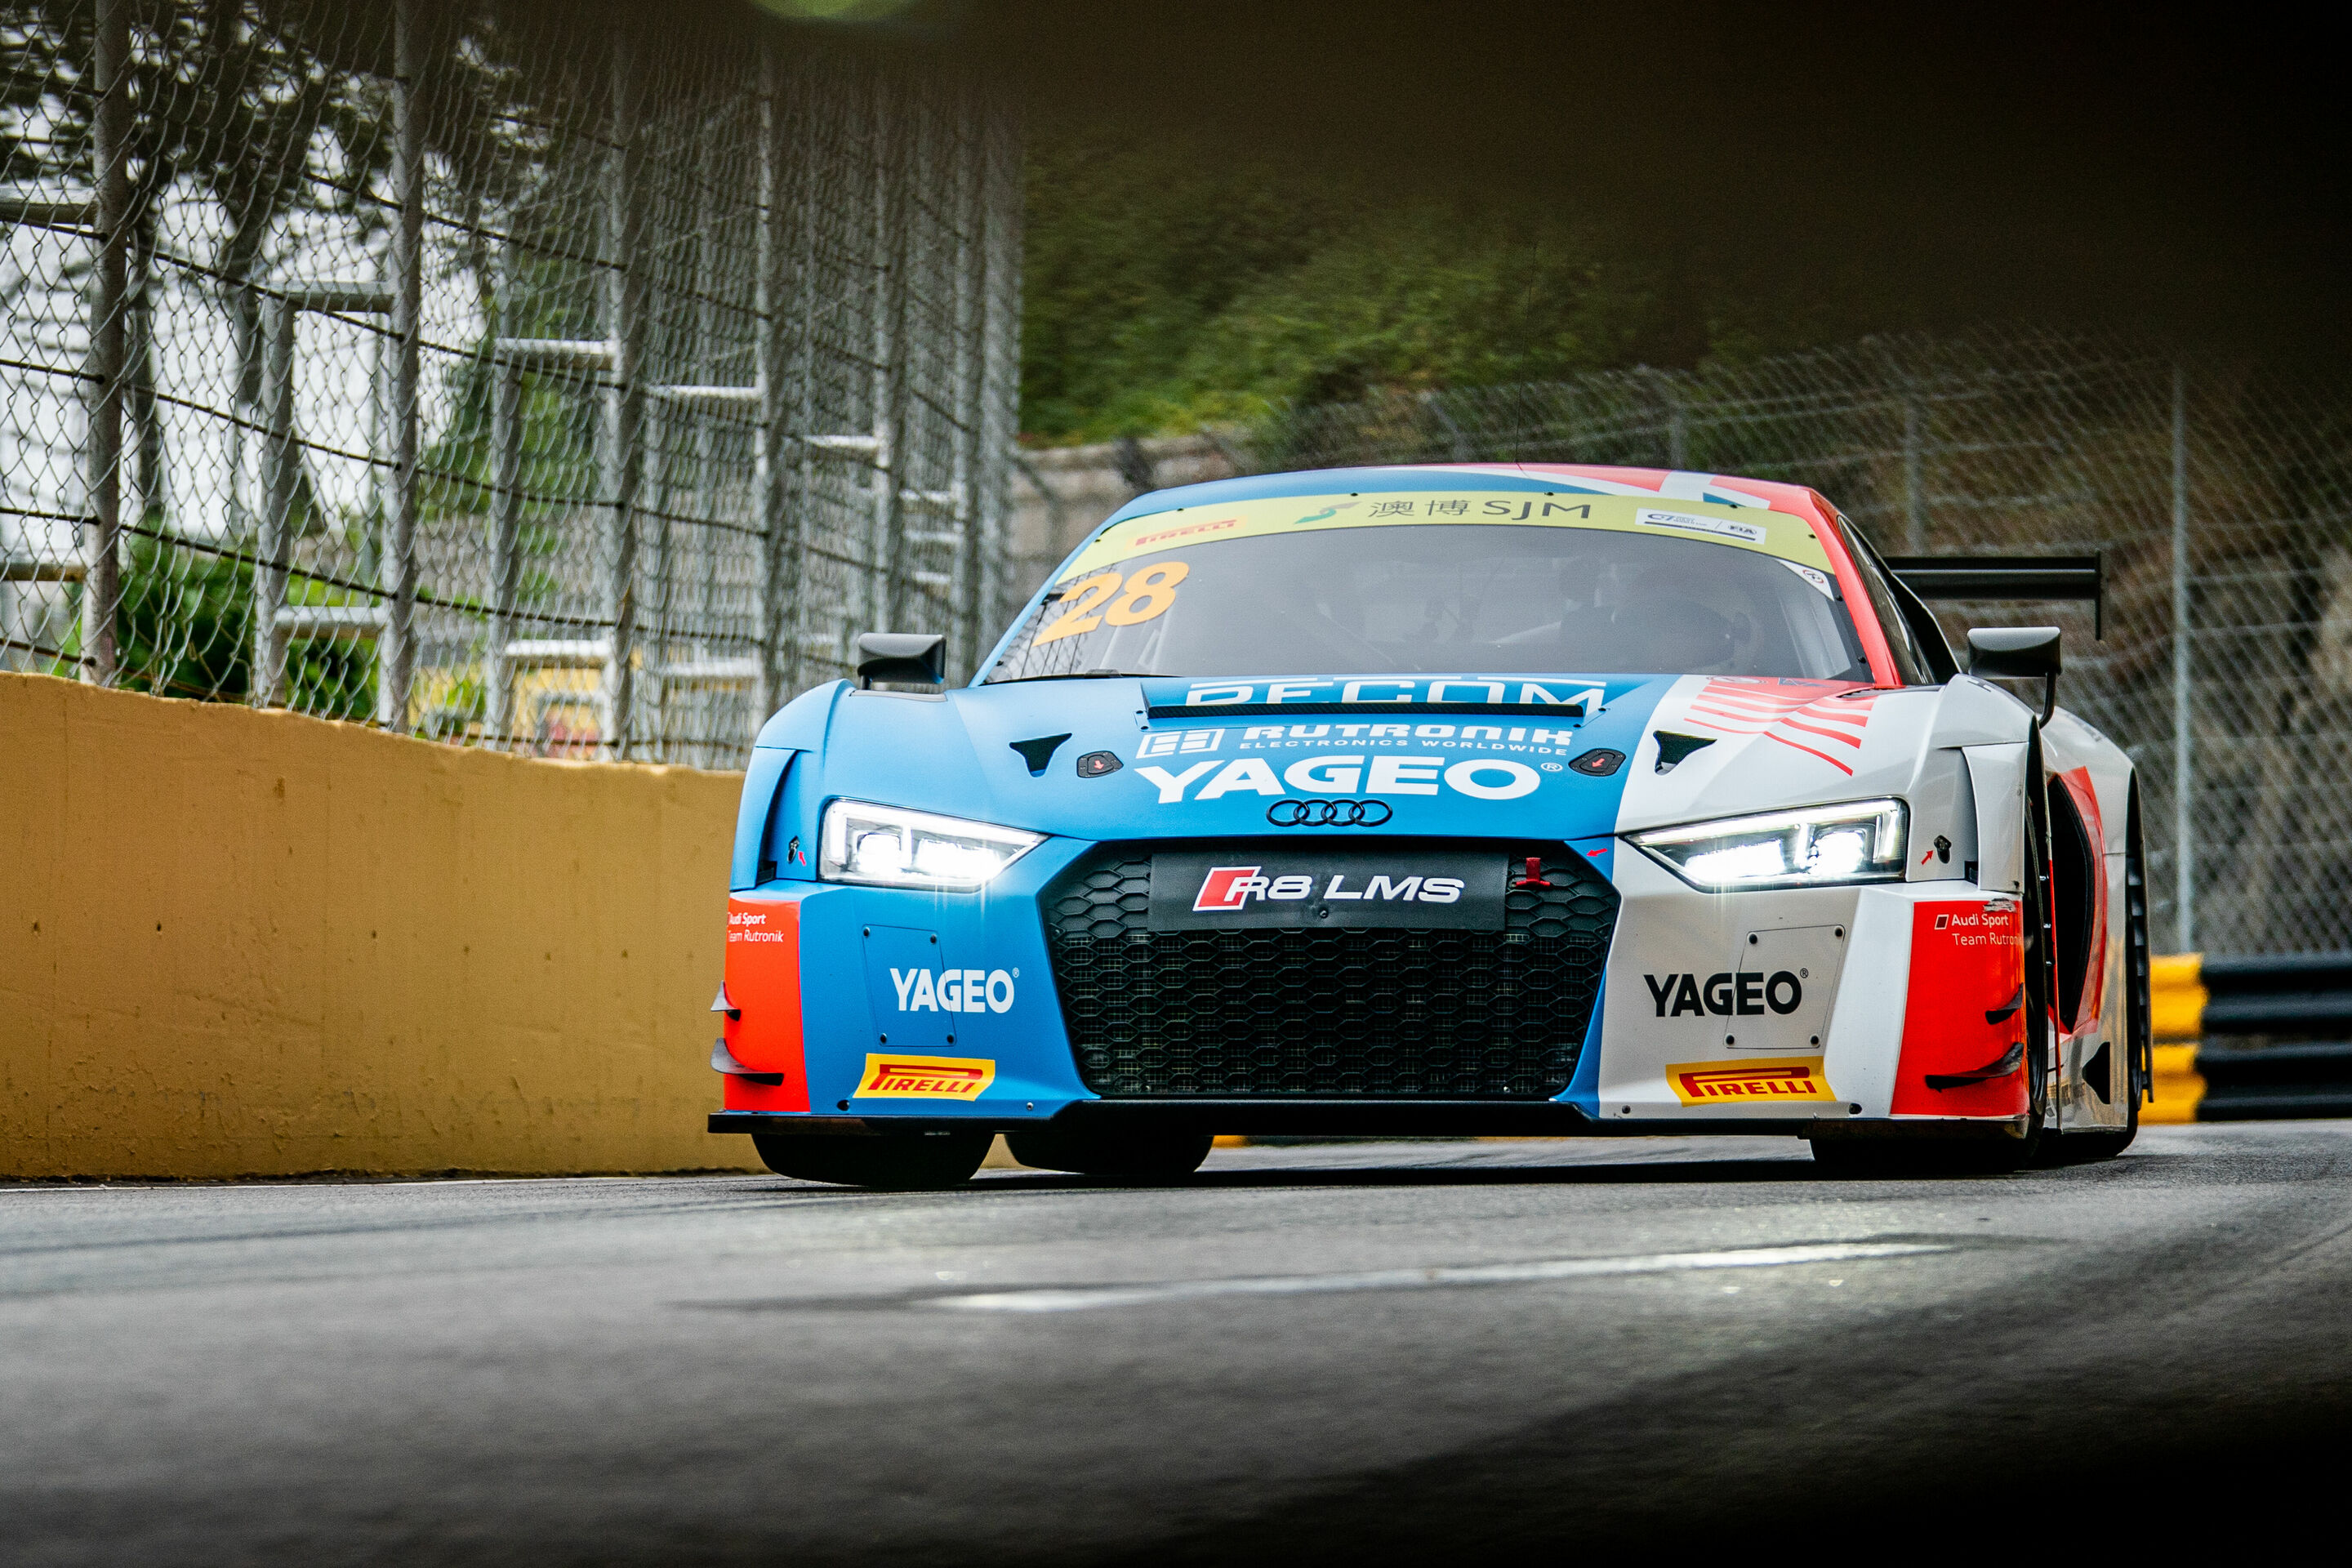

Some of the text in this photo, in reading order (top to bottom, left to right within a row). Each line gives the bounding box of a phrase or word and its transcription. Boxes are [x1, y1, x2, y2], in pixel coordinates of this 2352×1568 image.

[1482, 500, 1591, 519] SJM
[1031, 561, 1190, 647] 28
[1239, 738, 1568, 756] ELECTRONICS WORLDWIDE
[1323, 875, 1465, 904] LMS
[742, 912, 766, 927] Sport
[1951, 914, 2009, 928] Audi Sport
[744, 929, 784, 942] Rutronik
[1952, 933, 1987, 946] Team
[867, 1064, 983, 1094] PIRELLI
[1679, 1067, 1817, 1098] PIRELLI
